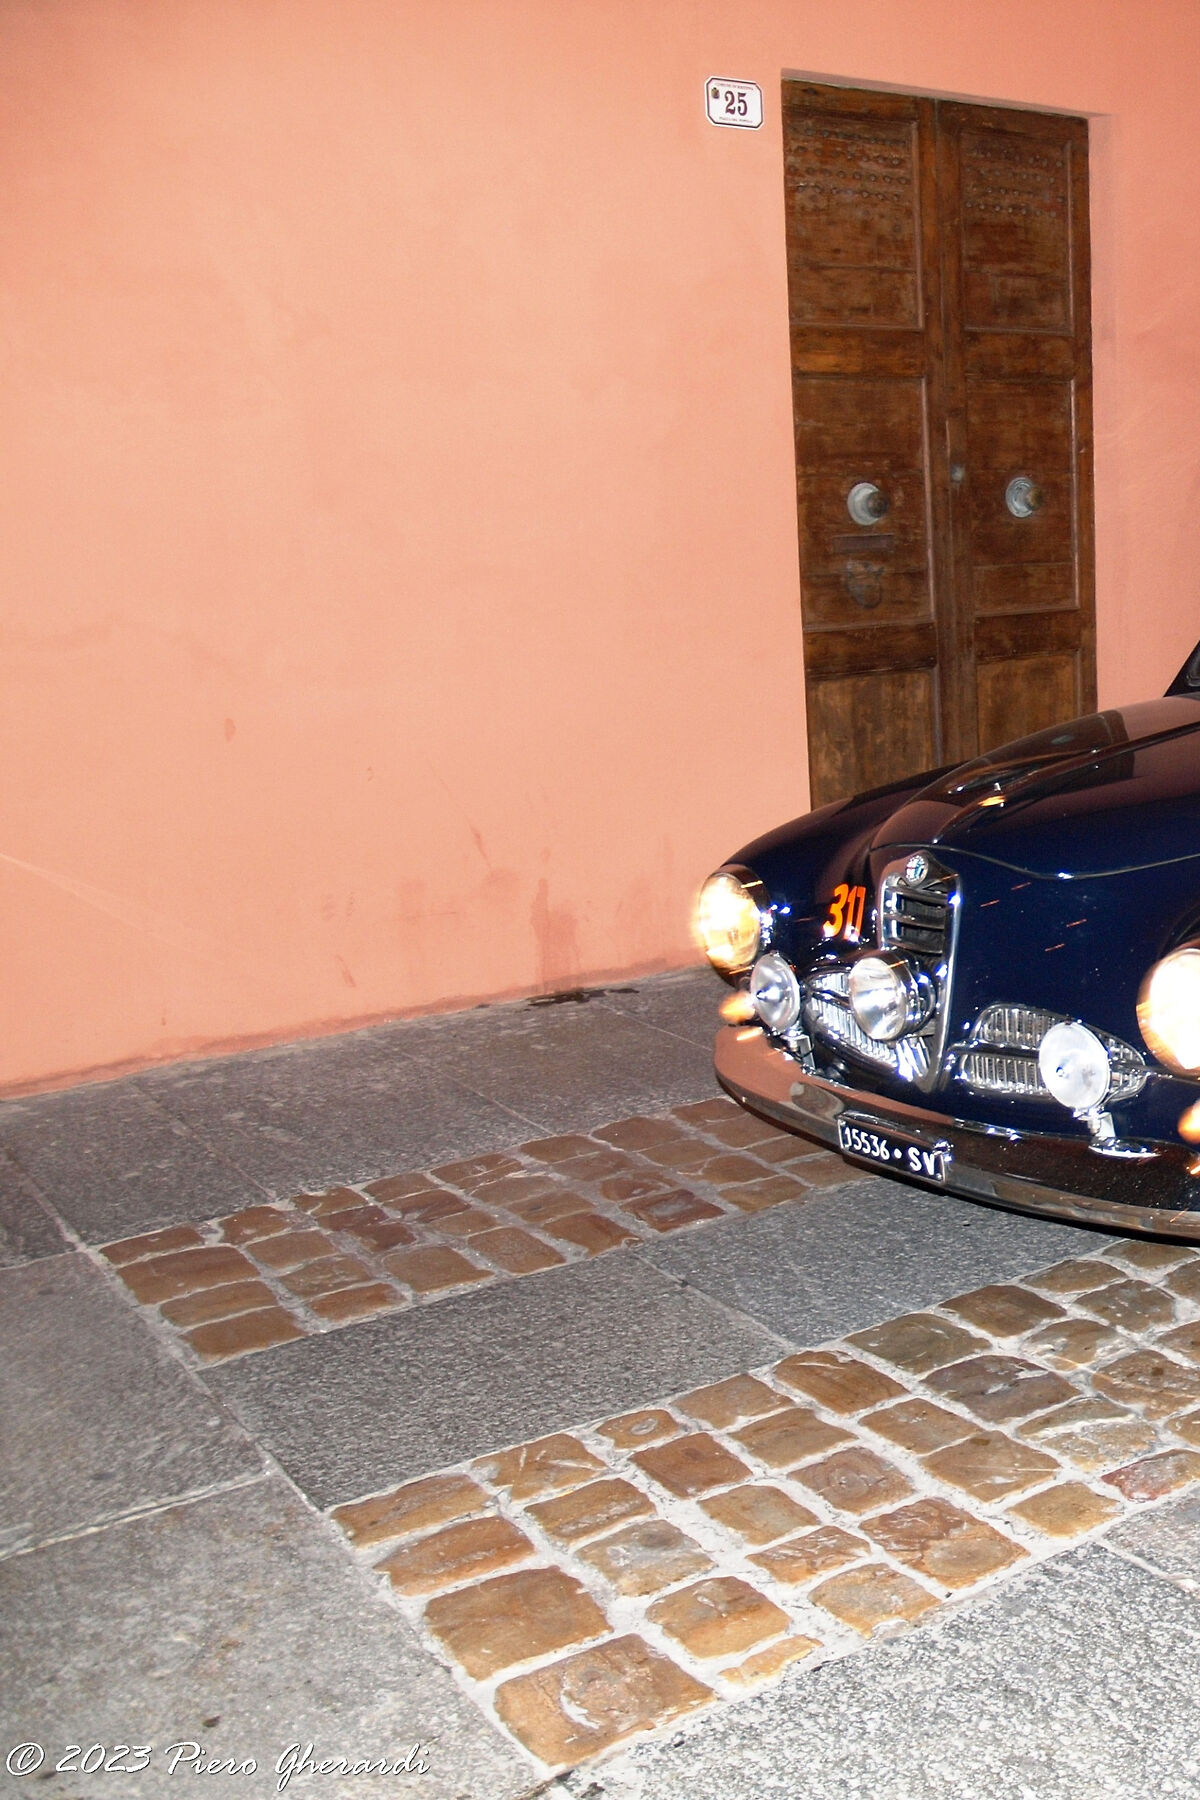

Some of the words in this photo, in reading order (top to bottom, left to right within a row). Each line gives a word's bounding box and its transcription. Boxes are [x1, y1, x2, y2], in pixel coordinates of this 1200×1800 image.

[725, 90, 748, 116] 25
[823, 883, 866, 941] 317
[844, 1126, 890, 1160] 15536
[908, 1146, 935, 1176] SV
